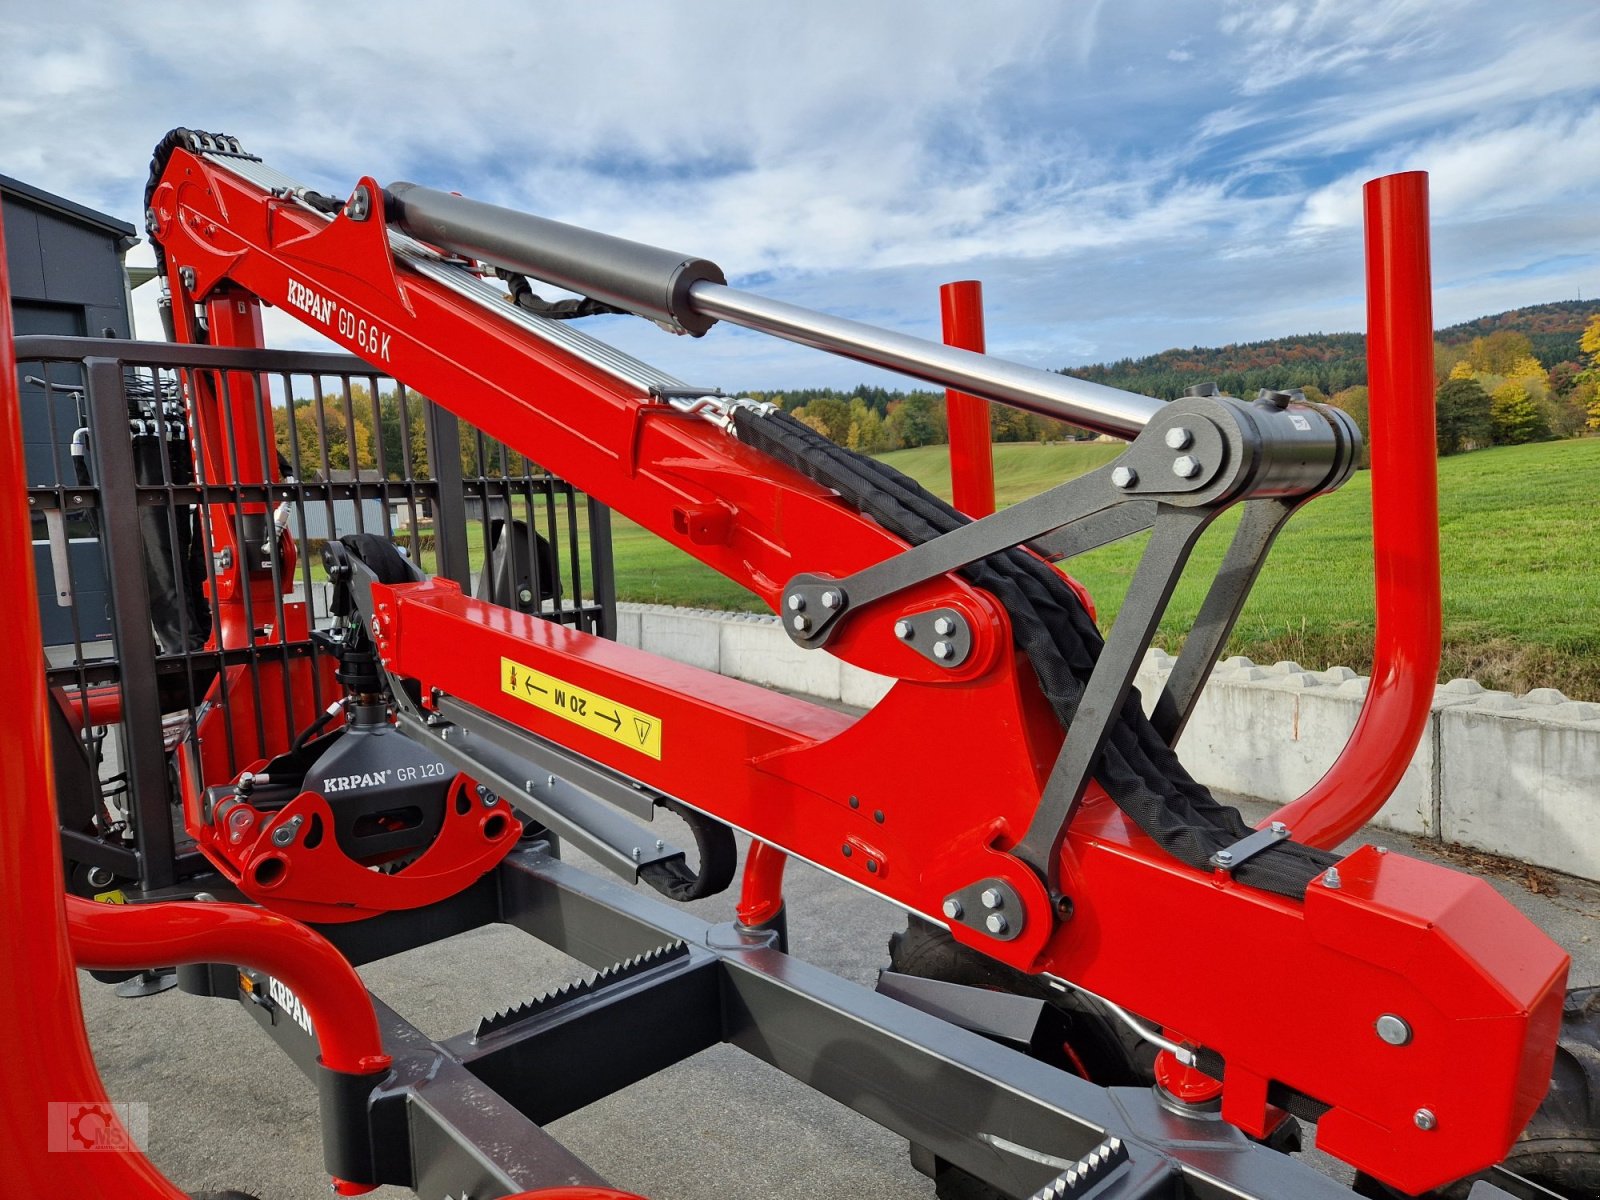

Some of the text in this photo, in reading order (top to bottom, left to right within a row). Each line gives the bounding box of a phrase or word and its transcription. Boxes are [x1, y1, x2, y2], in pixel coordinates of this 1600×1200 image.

[338, 307, 355, 340] GD
[381, 331, 392, 363] K
[554, 688, 587, 717] 20 M
[397, 766, 417, 782] GR
[419, 762, 445, 779] 120
[269, 975, 313, 1037] KRPAN
